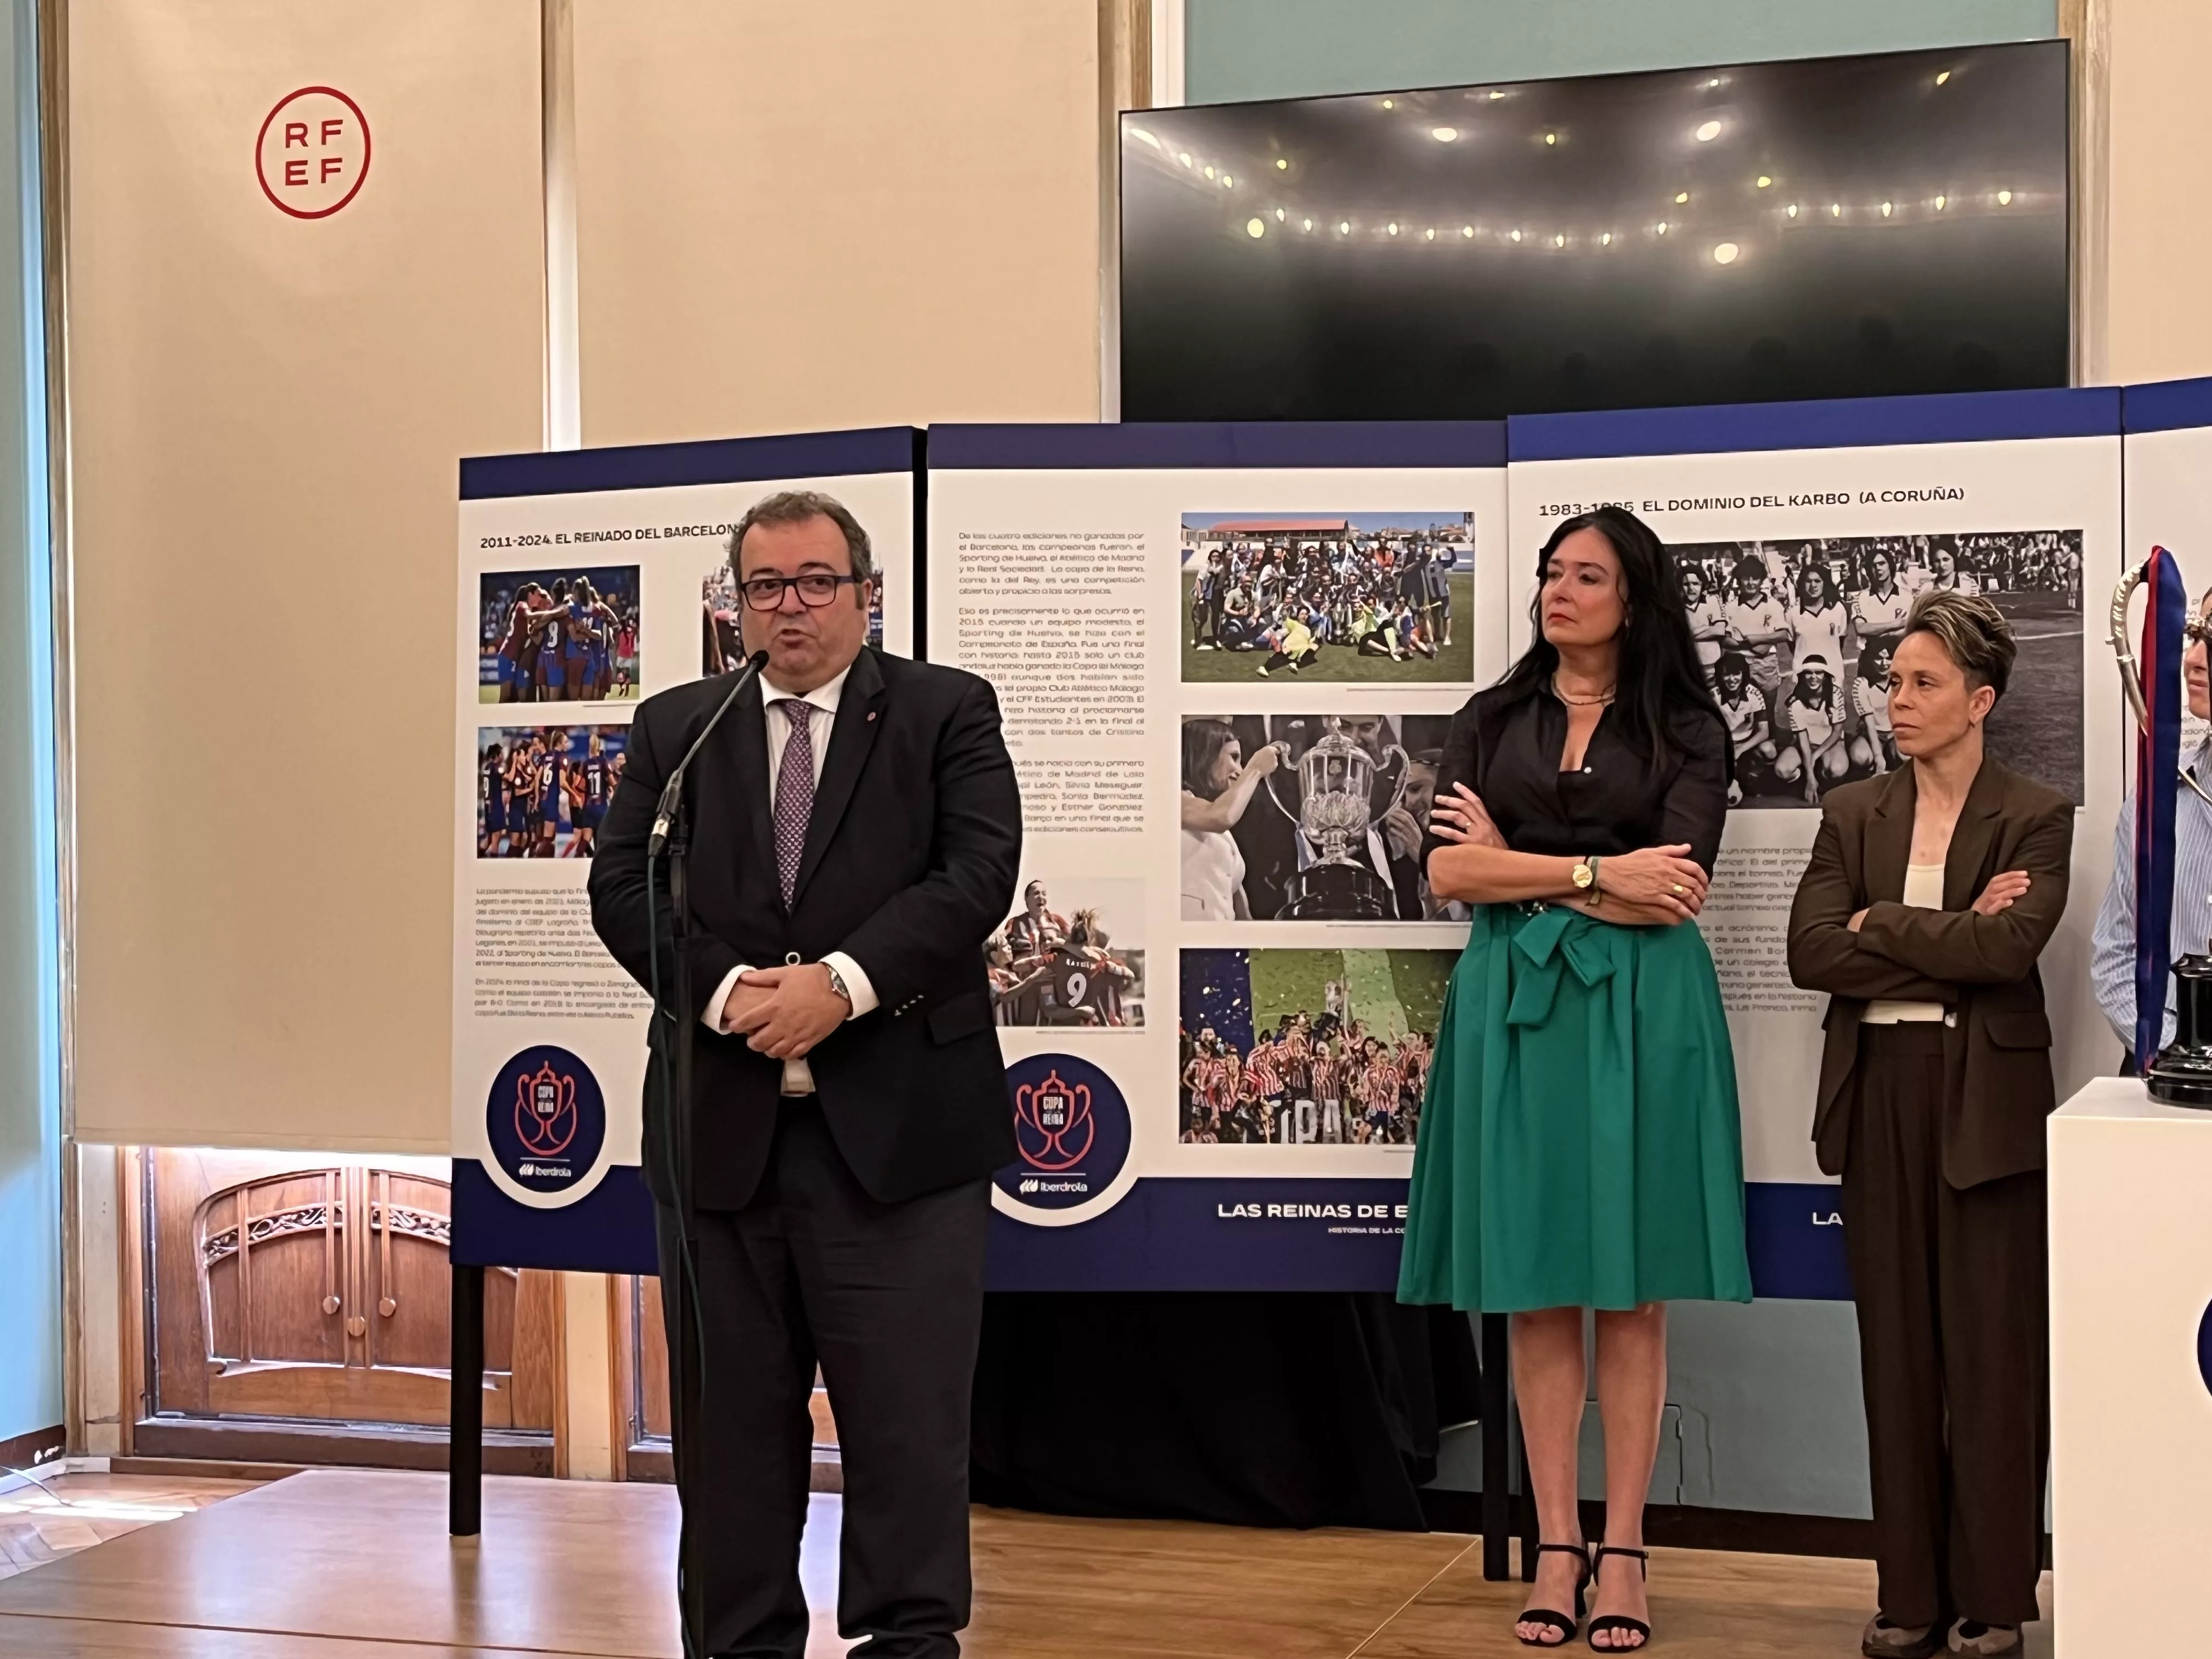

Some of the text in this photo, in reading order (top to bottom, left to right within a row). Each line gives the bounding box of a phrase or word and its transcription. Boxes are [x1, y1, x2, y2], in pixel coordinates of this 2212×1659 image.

[1643, 500, 1664, 512] EL
[1668, 498, 1745, 511] DOMINIO
[1750, 495, 1784, 507] DEL
[1788, 493, 1849, 505] KARBO
[1859, 490, 1877, 504] (A
[555, 534, 571, 544] EL
[574, 530, 632, 543] REINADO
[635, 529, 661, 539] DEL
[664, 524, 738, 537] BARCELON
[1067, 973, 1087, 1007] 9
[1218, 1204, 1261, 1217] LAS
[1268, 1204, 1351, 1218] REINAS
[1358, 1205, 1387, 1218] DE
